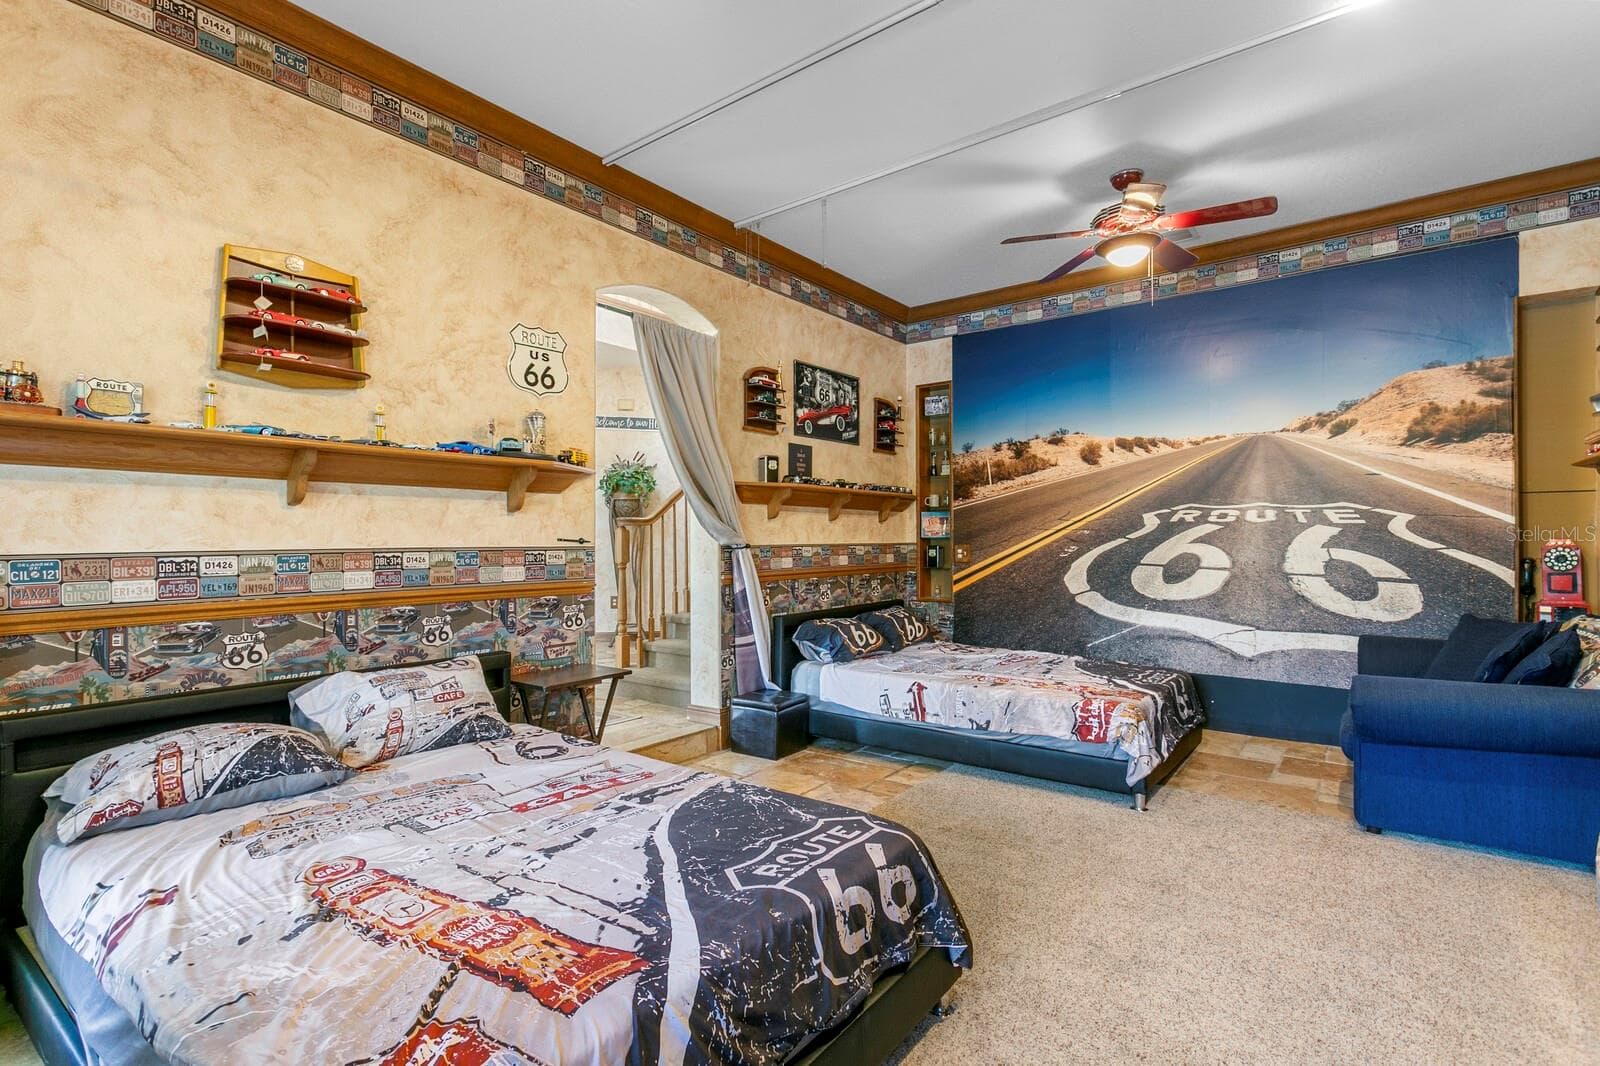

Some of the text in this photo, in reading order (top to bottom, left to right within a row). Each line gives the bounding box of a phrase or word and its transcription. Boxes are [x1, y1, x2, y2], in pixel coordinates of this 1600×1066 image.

[202, 16, 231, 35] D1426
[521, 330, 557, 349] ROUTE
[529, 350, 550, 362] US
[523, 363, 556, 390] 66
[96, 381, 128, 391] ROUTE
[819, 389, 831, 401] 66
[1170, 508, 1367, 524] ROUTE
[159, 562, 197, 573] DBL-314
[204, 561, 233, 570] D1426
[241, 556, 274, 568] JAN 726
[10, 570, 59, 581] CIL 121
[1130, 524, 1425, 622] 66
[160, 584, 197, 594] API-950
[201, 583, 237, 592] YEL 169
[242, 583, 274, 594] JN1960
[565, 616, 583, 628] 66
[425, 626, 449, 644] 66
[228, 644, 263, 666] 66
[180, 671, 233, 690] CHICAGO
[440, 681, 461, 691] EAT
[436, 691, 464, 701] CAFE
[752, 825, 862, 877] ROUTE
[816, 843, 917, 955] 66
